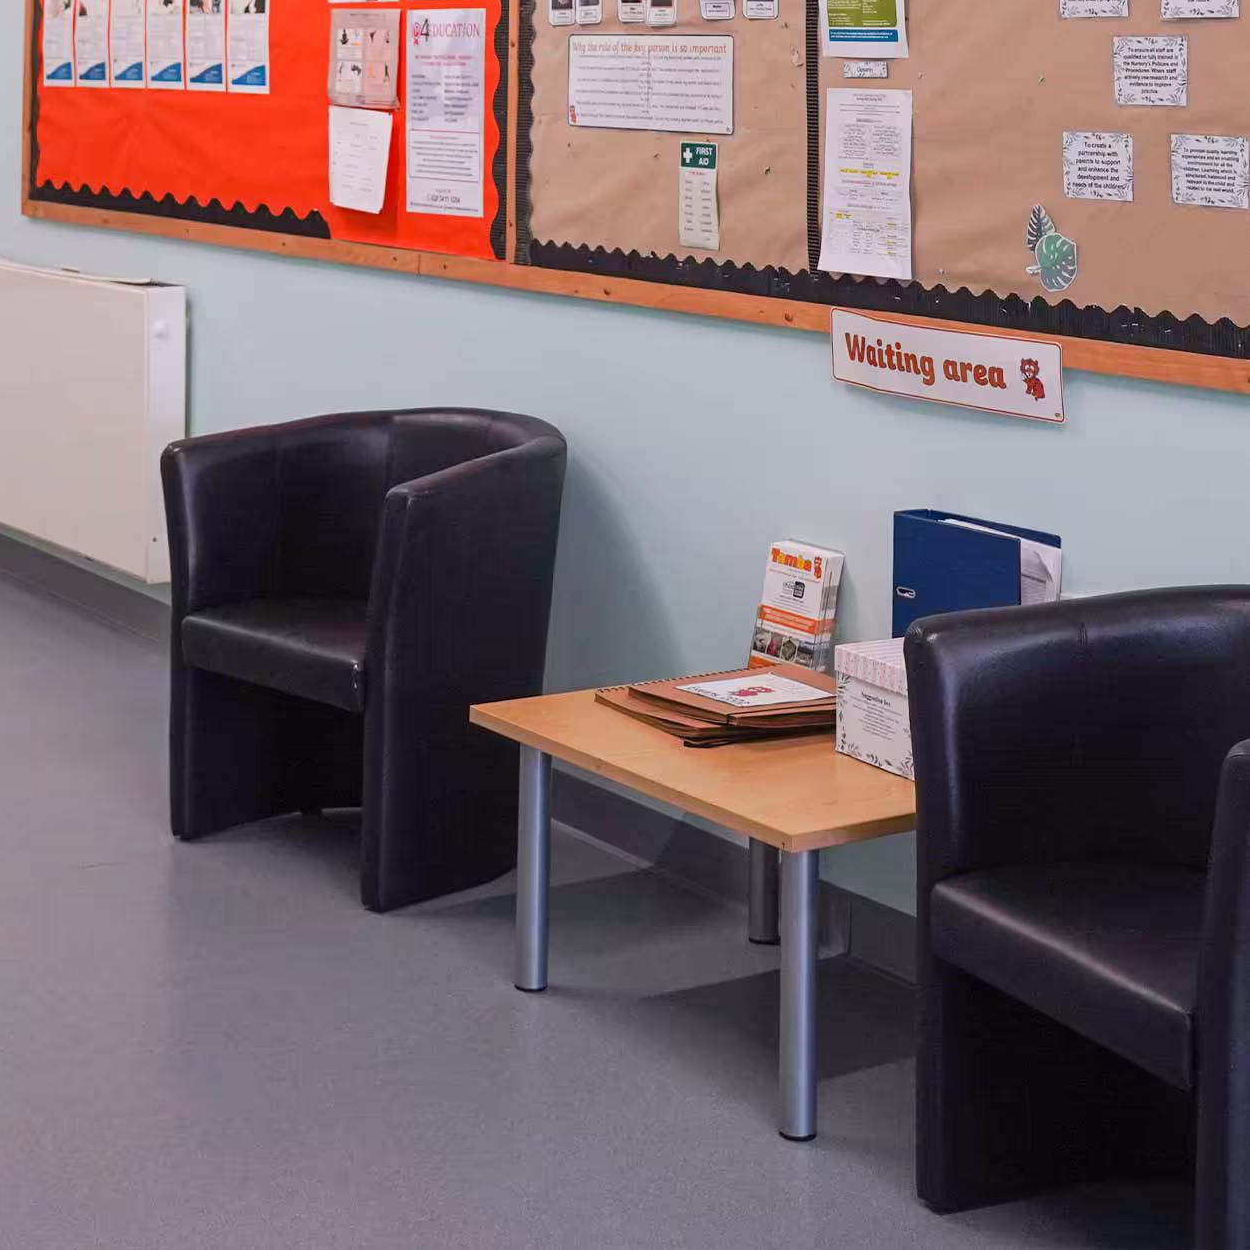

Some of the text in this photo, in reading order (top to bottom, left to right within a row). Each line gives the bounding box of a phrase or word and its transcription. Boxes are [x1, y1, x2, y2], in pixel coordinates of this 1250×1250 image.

[574, 42, 727, 55] Why the role of the key person is so important
[696, 147, 713, 156] FIRST
[698, 157, 710, 166] AID
[845, 332, 1007, 390] Waiting area
[771, 547, 813, 572] Tamba
